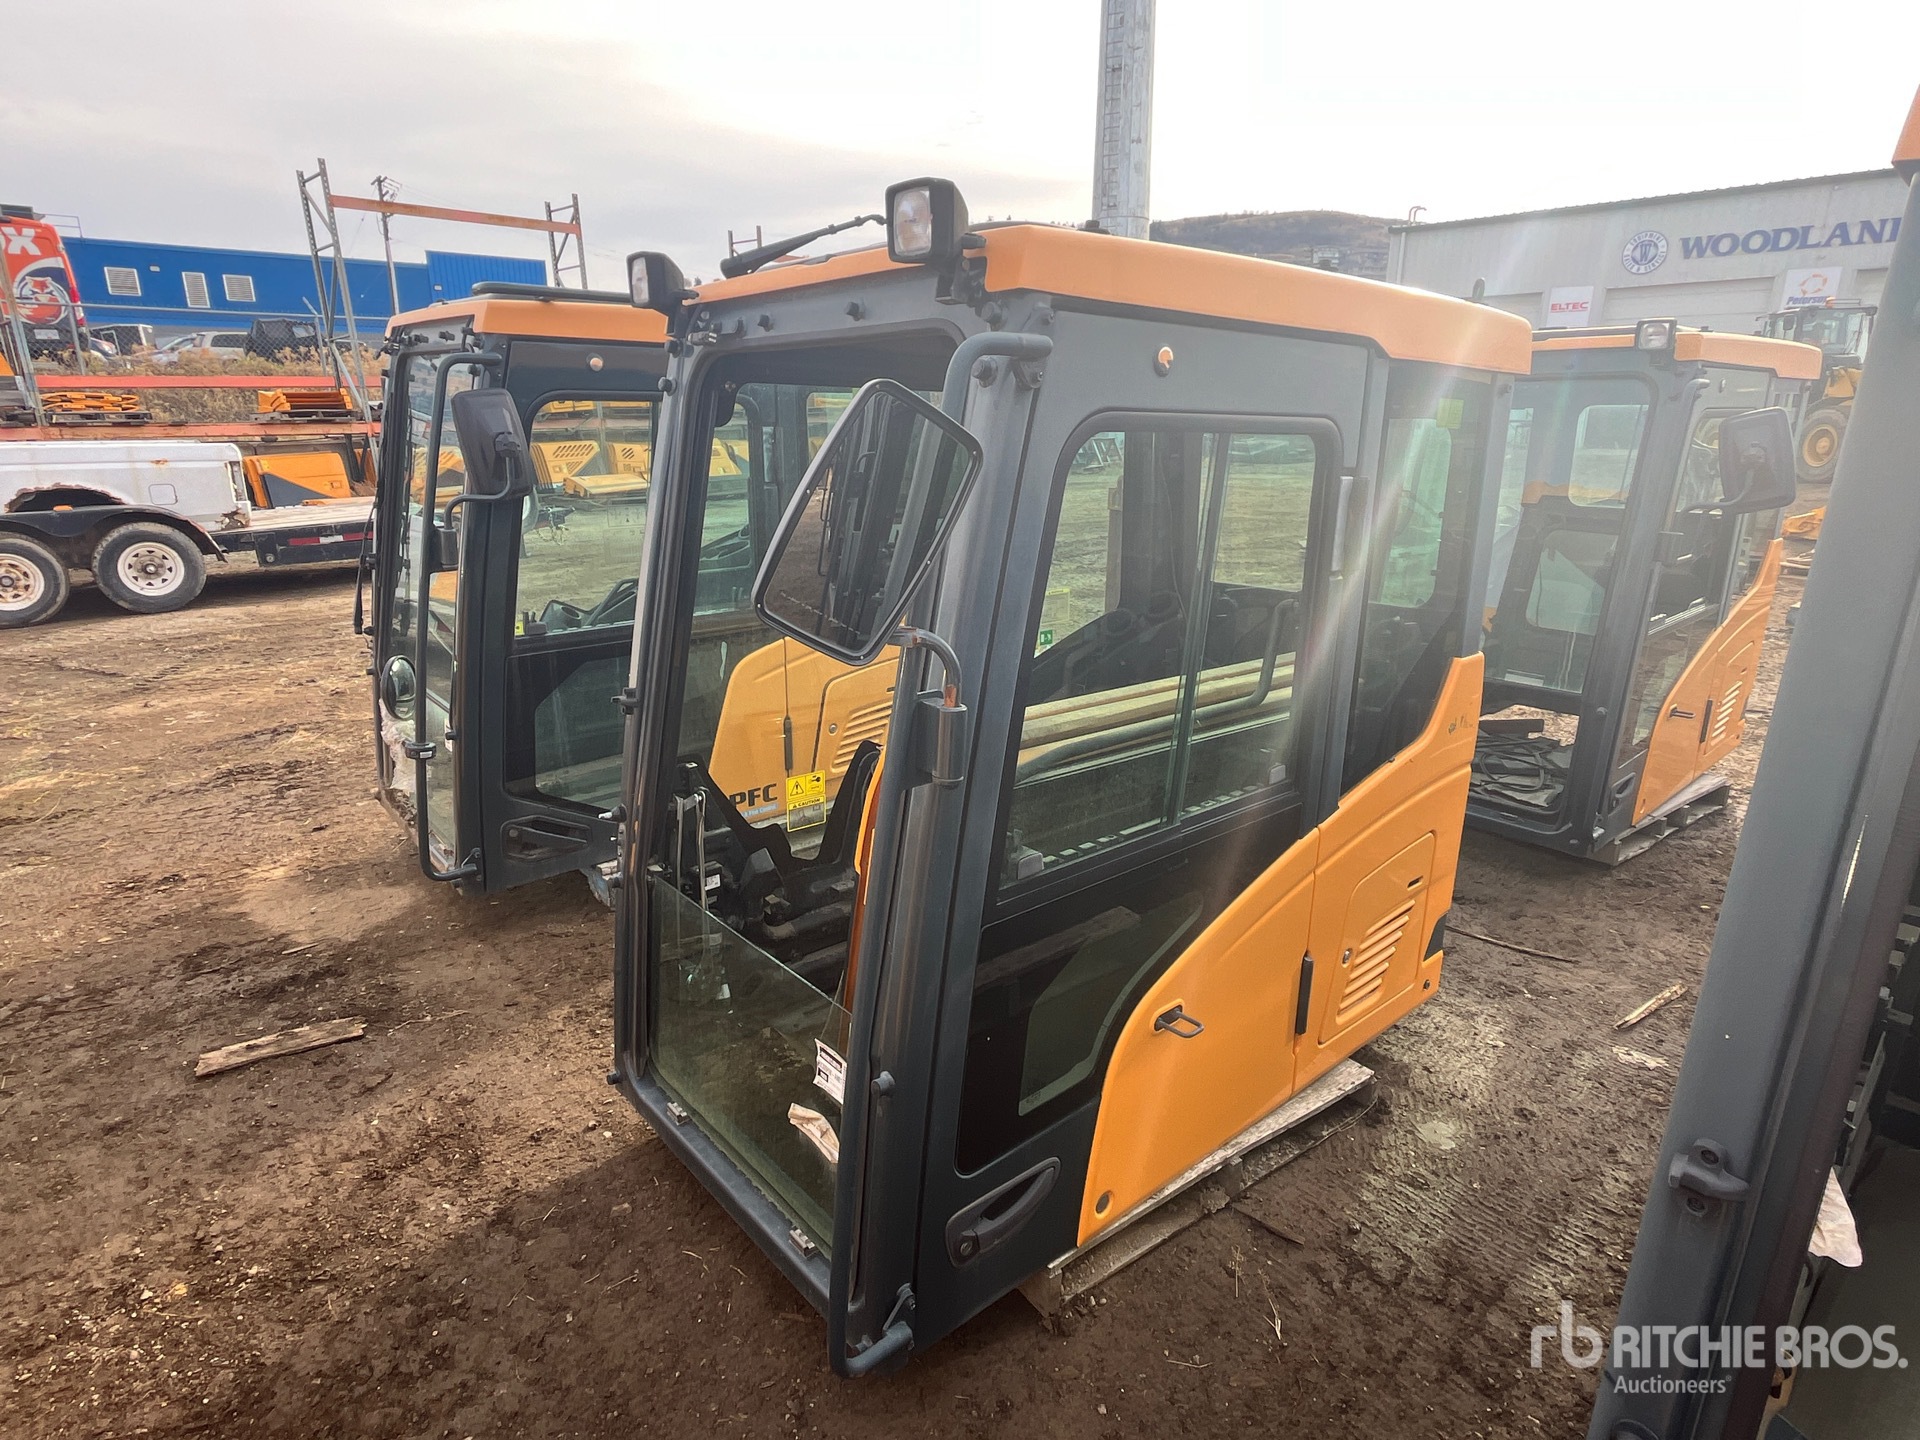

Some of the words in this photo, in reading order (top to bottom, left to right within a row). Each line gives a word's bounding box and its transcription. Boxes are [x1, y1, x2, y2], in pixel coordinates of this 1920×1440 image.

[1551, 301, 1589, 311] ELTEC
[729, 783, 778, 807] PFC
[798, 797, 821, 807] CAUTION
